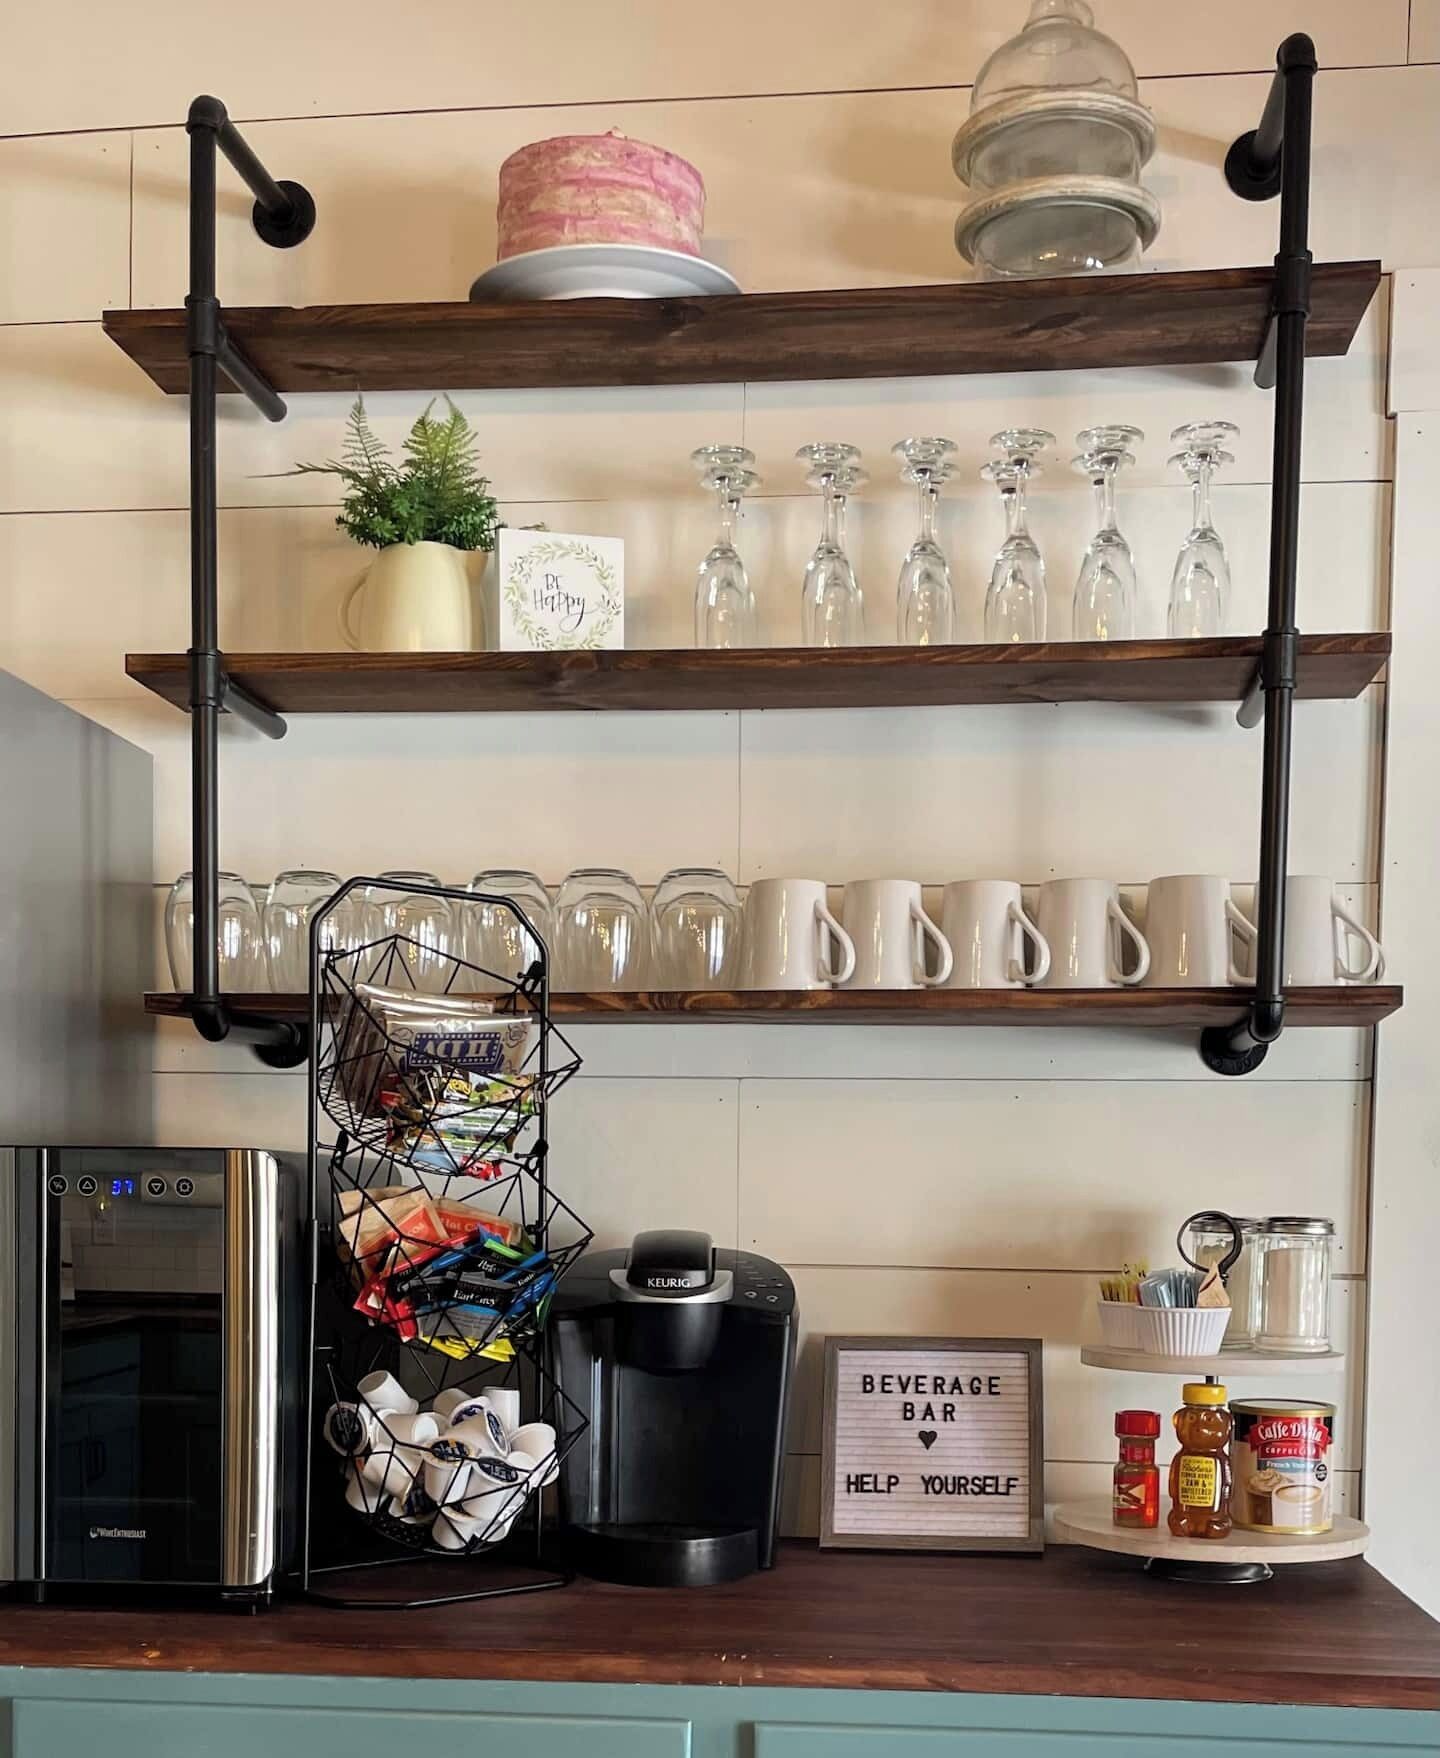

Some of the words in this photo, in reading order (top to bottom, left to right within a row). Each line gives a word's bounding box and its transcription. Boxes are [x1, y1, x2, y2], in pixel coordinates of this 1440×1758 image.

[545, 573, 564, 591] BE
[533, 588, 591, 631] Happy
[420, 1039, 465, 1058] ACT
[465, 1039, 491, 1058] II
[111, 1178, 135, 1196] 37
[647, 1277, 690, 1288] KEURIG
[862, 1374, 1001, 1395] BEVERAGE
[903, 1402, 956, 1422] BAR
[1257, 1421, 1289, 1440] Caffe
[846, 1474, 900, 1493] HELP
[920, 1475, 1020, 1496] YOURSELF
